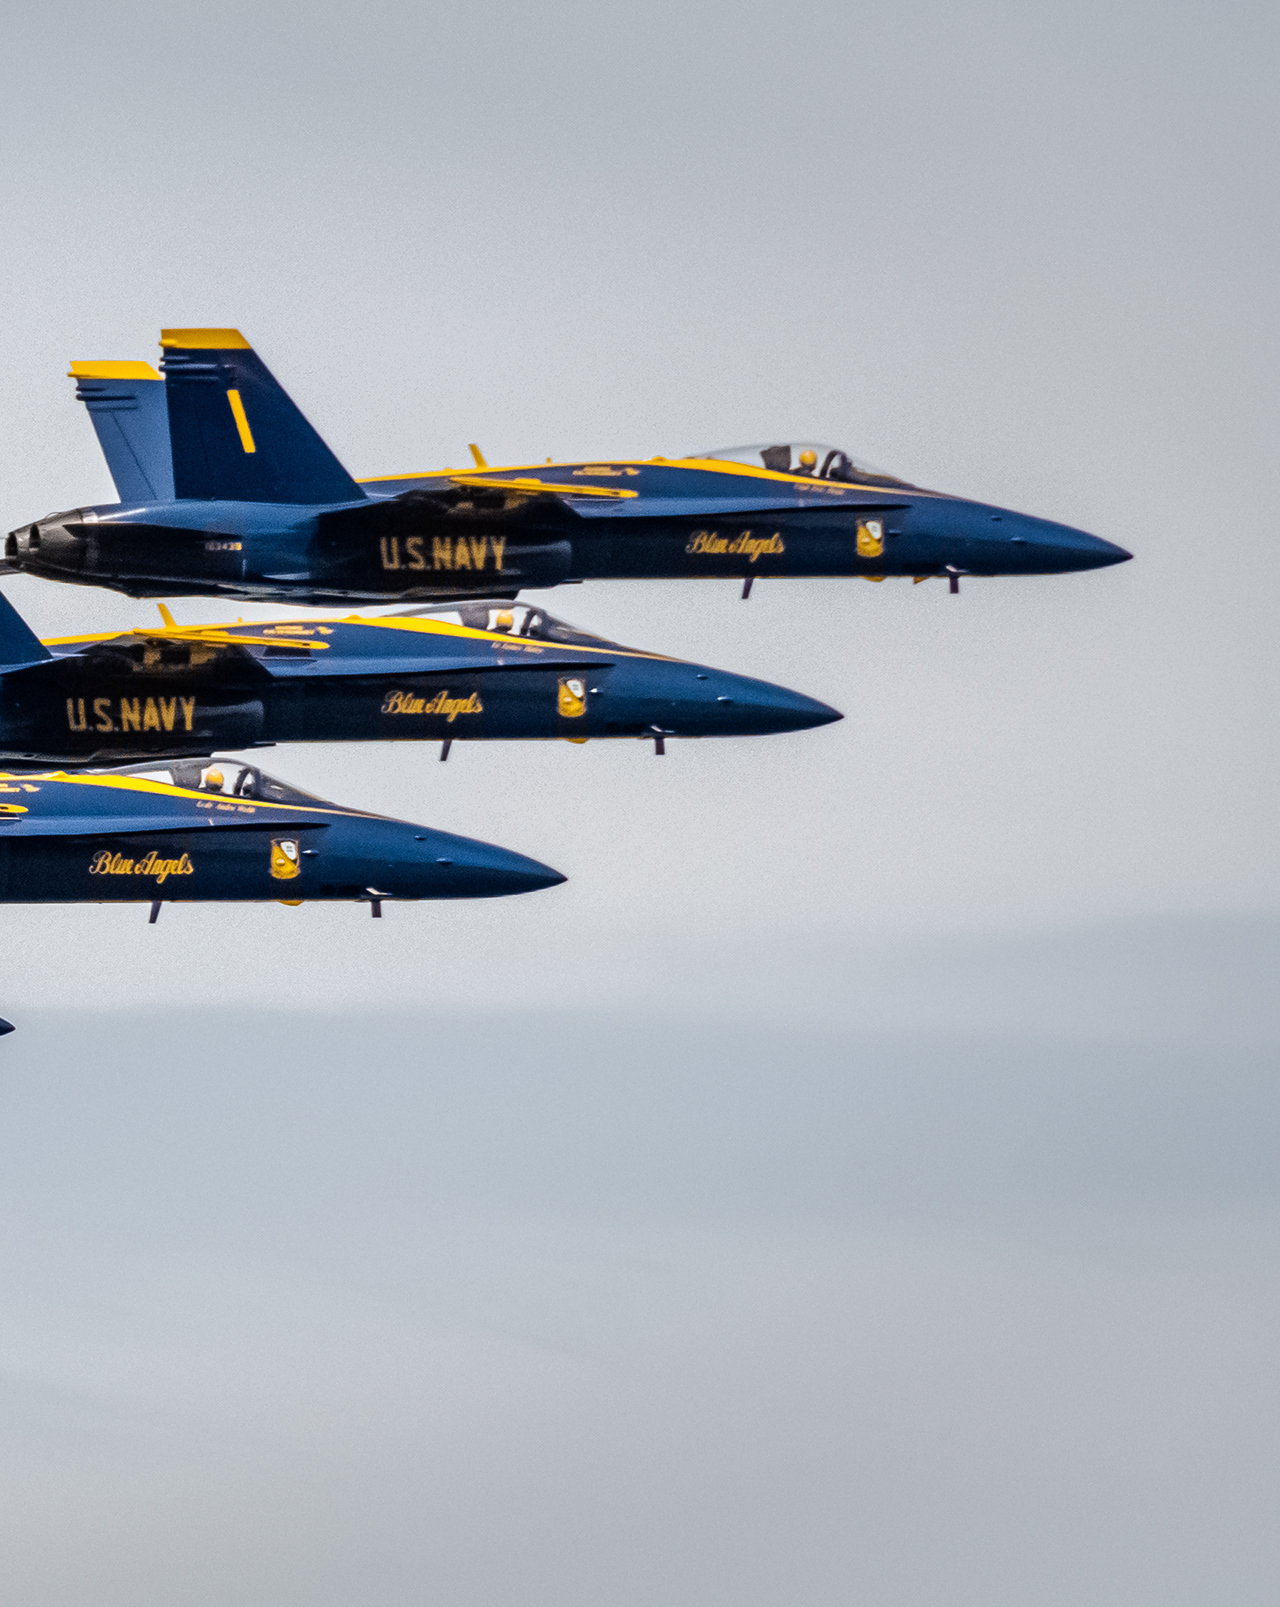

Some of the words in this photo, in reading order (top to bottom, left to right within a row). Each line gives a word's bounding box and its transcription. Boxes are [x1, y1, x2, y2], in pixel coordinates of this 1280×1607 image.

[227, 389, 256, 453] 1
[685, 530, 728, 553] Blue
[728, 531, 784, 563] Angels
[381, 690, 426, 713] Blue
[425, 690, 483, 722] Angels
[89, 850, 134, 874] Blue
[134, 850, 194, 884] Angels
